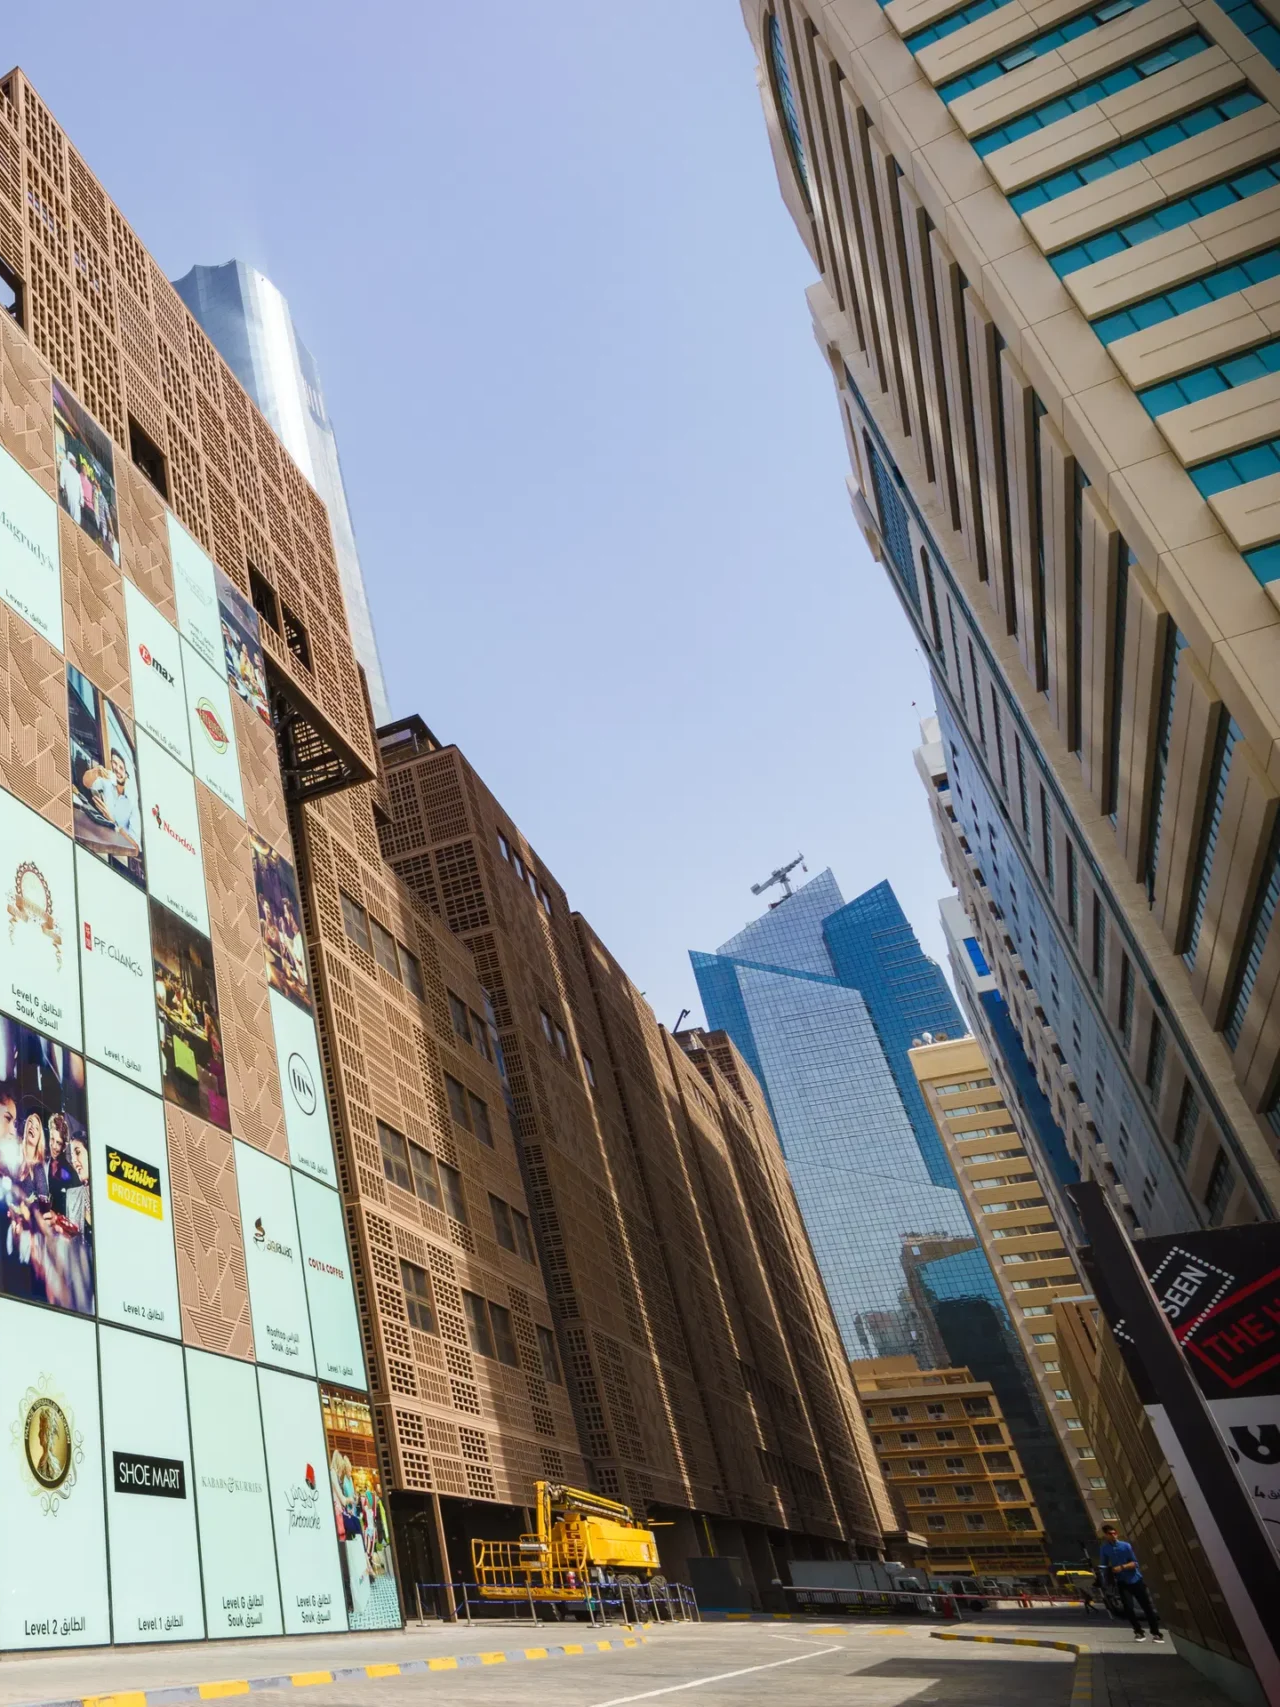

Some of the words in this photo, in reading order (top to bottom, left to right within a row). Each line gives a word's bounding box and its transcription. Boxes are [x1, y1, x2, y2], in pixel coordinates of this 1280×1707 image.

[163, 820, 197, 855] Nando's
[11, 984, 33, 1004] Level
[41, 1000, 63, 1019] الطابق
[15, 1000, 35, 1019] Souk
[36, 1013, 59, 1031] السوق
[104, 1046, 120, 1063] Level
[121, 1161, 158, 1189] Tchibo
[111, 1182, 159, 1213] PROZENTE
[308, 1257, 326, 1273] COSTA
[326, 1264, 344, 1280] COFFEE
[1161, 1264, 1208, 1319] SEEN
[123, 1301, 141, 1317] Level
[147, 1308, 165, 1321] الطابق
[1202, 1311, 1275, 1362] THE
[119, 1461, 150, 1487] SHOE
[152, 1467, 180, 1490] MART
[286, 1508, 321, 1535] Tarbouche
[223, 1596, 239, 1610] Level
[246, 1595, 264, 1610] الطابق
[296, 1595, 311, 1607] Level
[316, 1594, 332, 1609] الطابق
[25, 1620, 50, 1636] Level
[52, 1619, 58, 1635] 2
[60, 1616, 85, 1636] الطابق
[138, 1617, 157, 1631] Level
[159, 1617, 163, 1629] 1
[165, 1615, 183, 1631] الطابق
[228, 1613, 244, 1627] Souk
[245, 1612, 263, 1629] السوق
[301, 1610, 315, 1624] Souk
[316, 1610, 331, 1626] السوق
